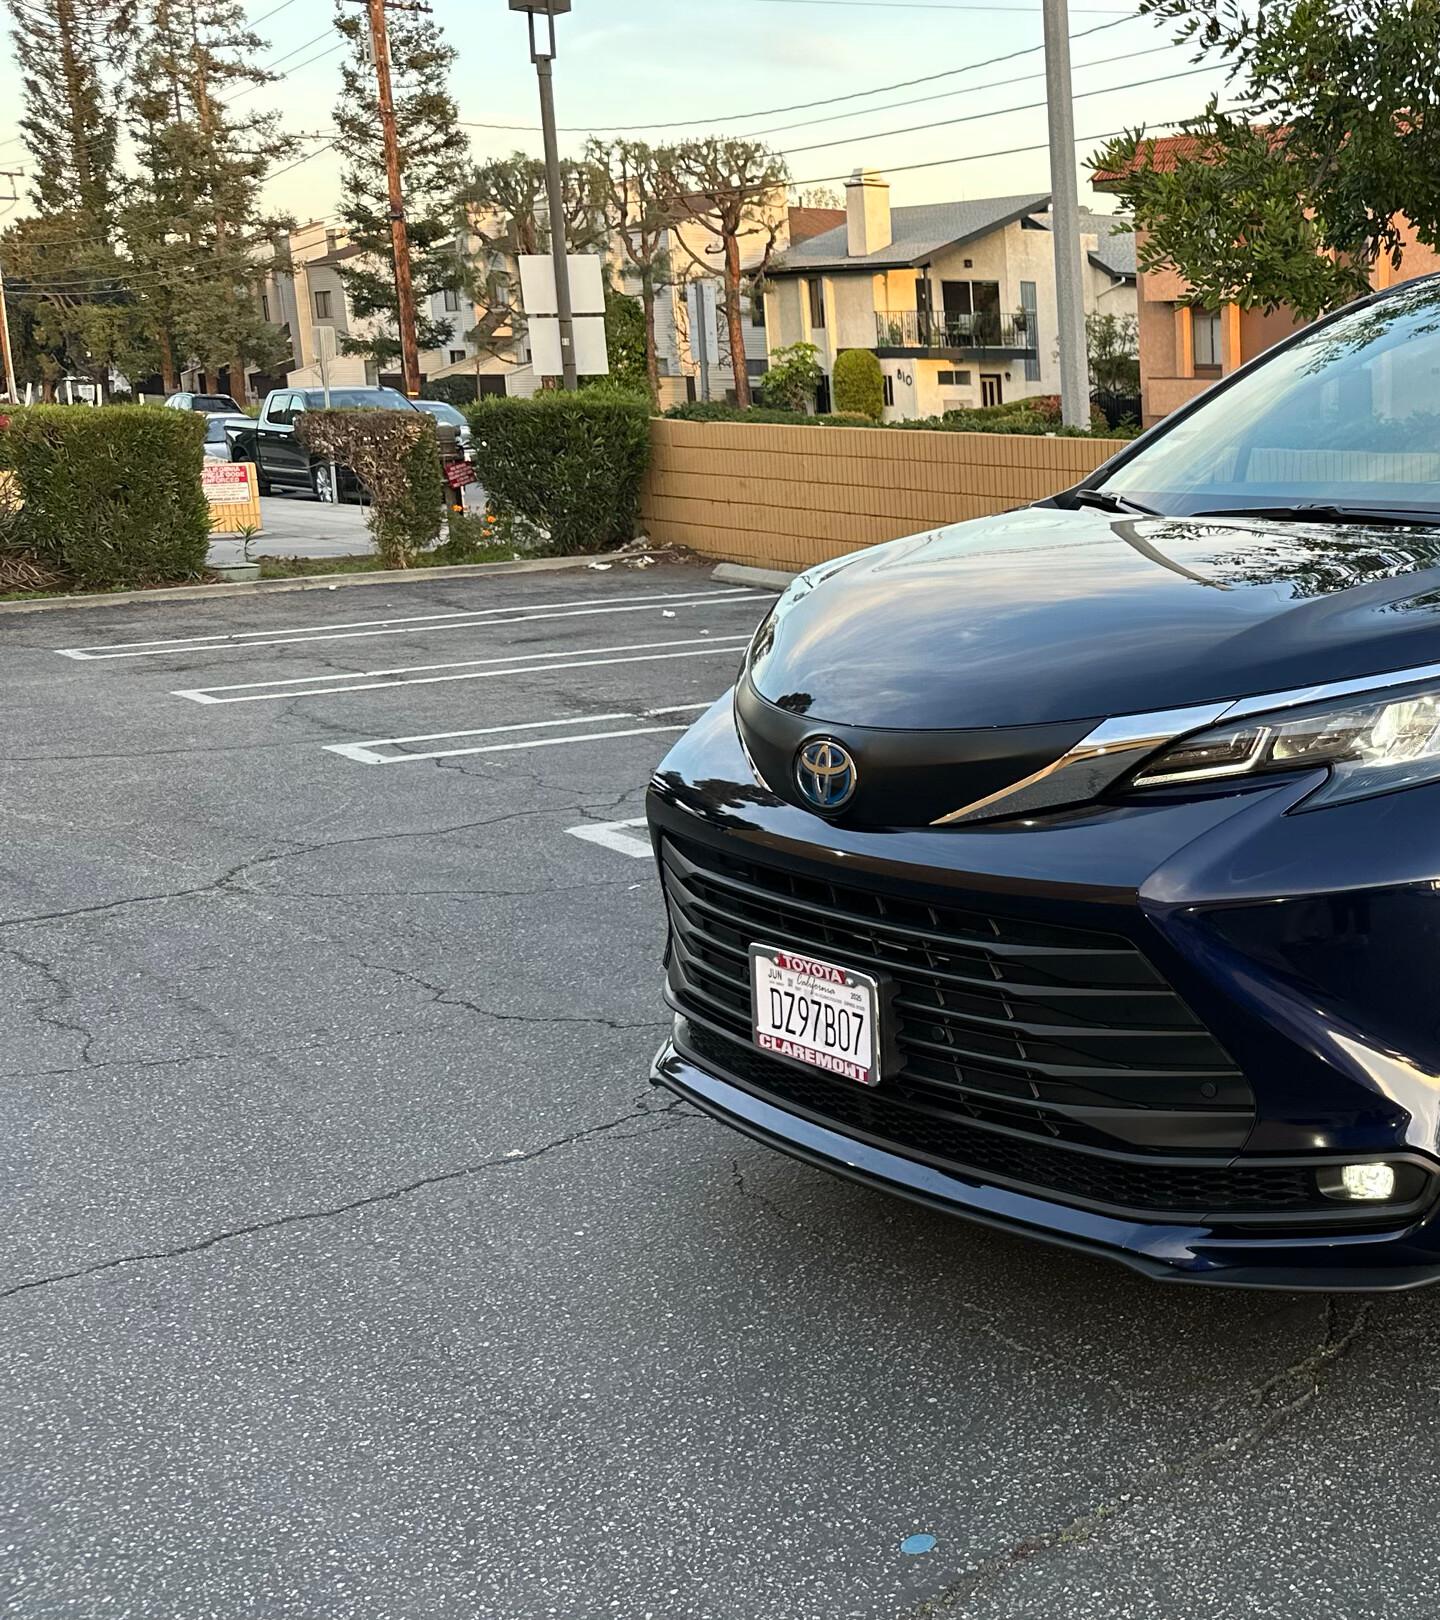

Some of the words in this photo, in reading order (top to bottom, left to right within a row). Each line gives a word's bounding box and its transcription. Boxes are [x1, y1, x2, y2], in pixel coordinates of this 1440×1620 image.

[897, 368, 912, 386] 810
[767, 968, 783, 981] JUN
[783, 955, 843, 984] TOYOTA
[796, 973, 836, 995] California
[769, 987, 864, 1056] DZ97B07
[759, 1033, 869, 1082] CLAREMONT
